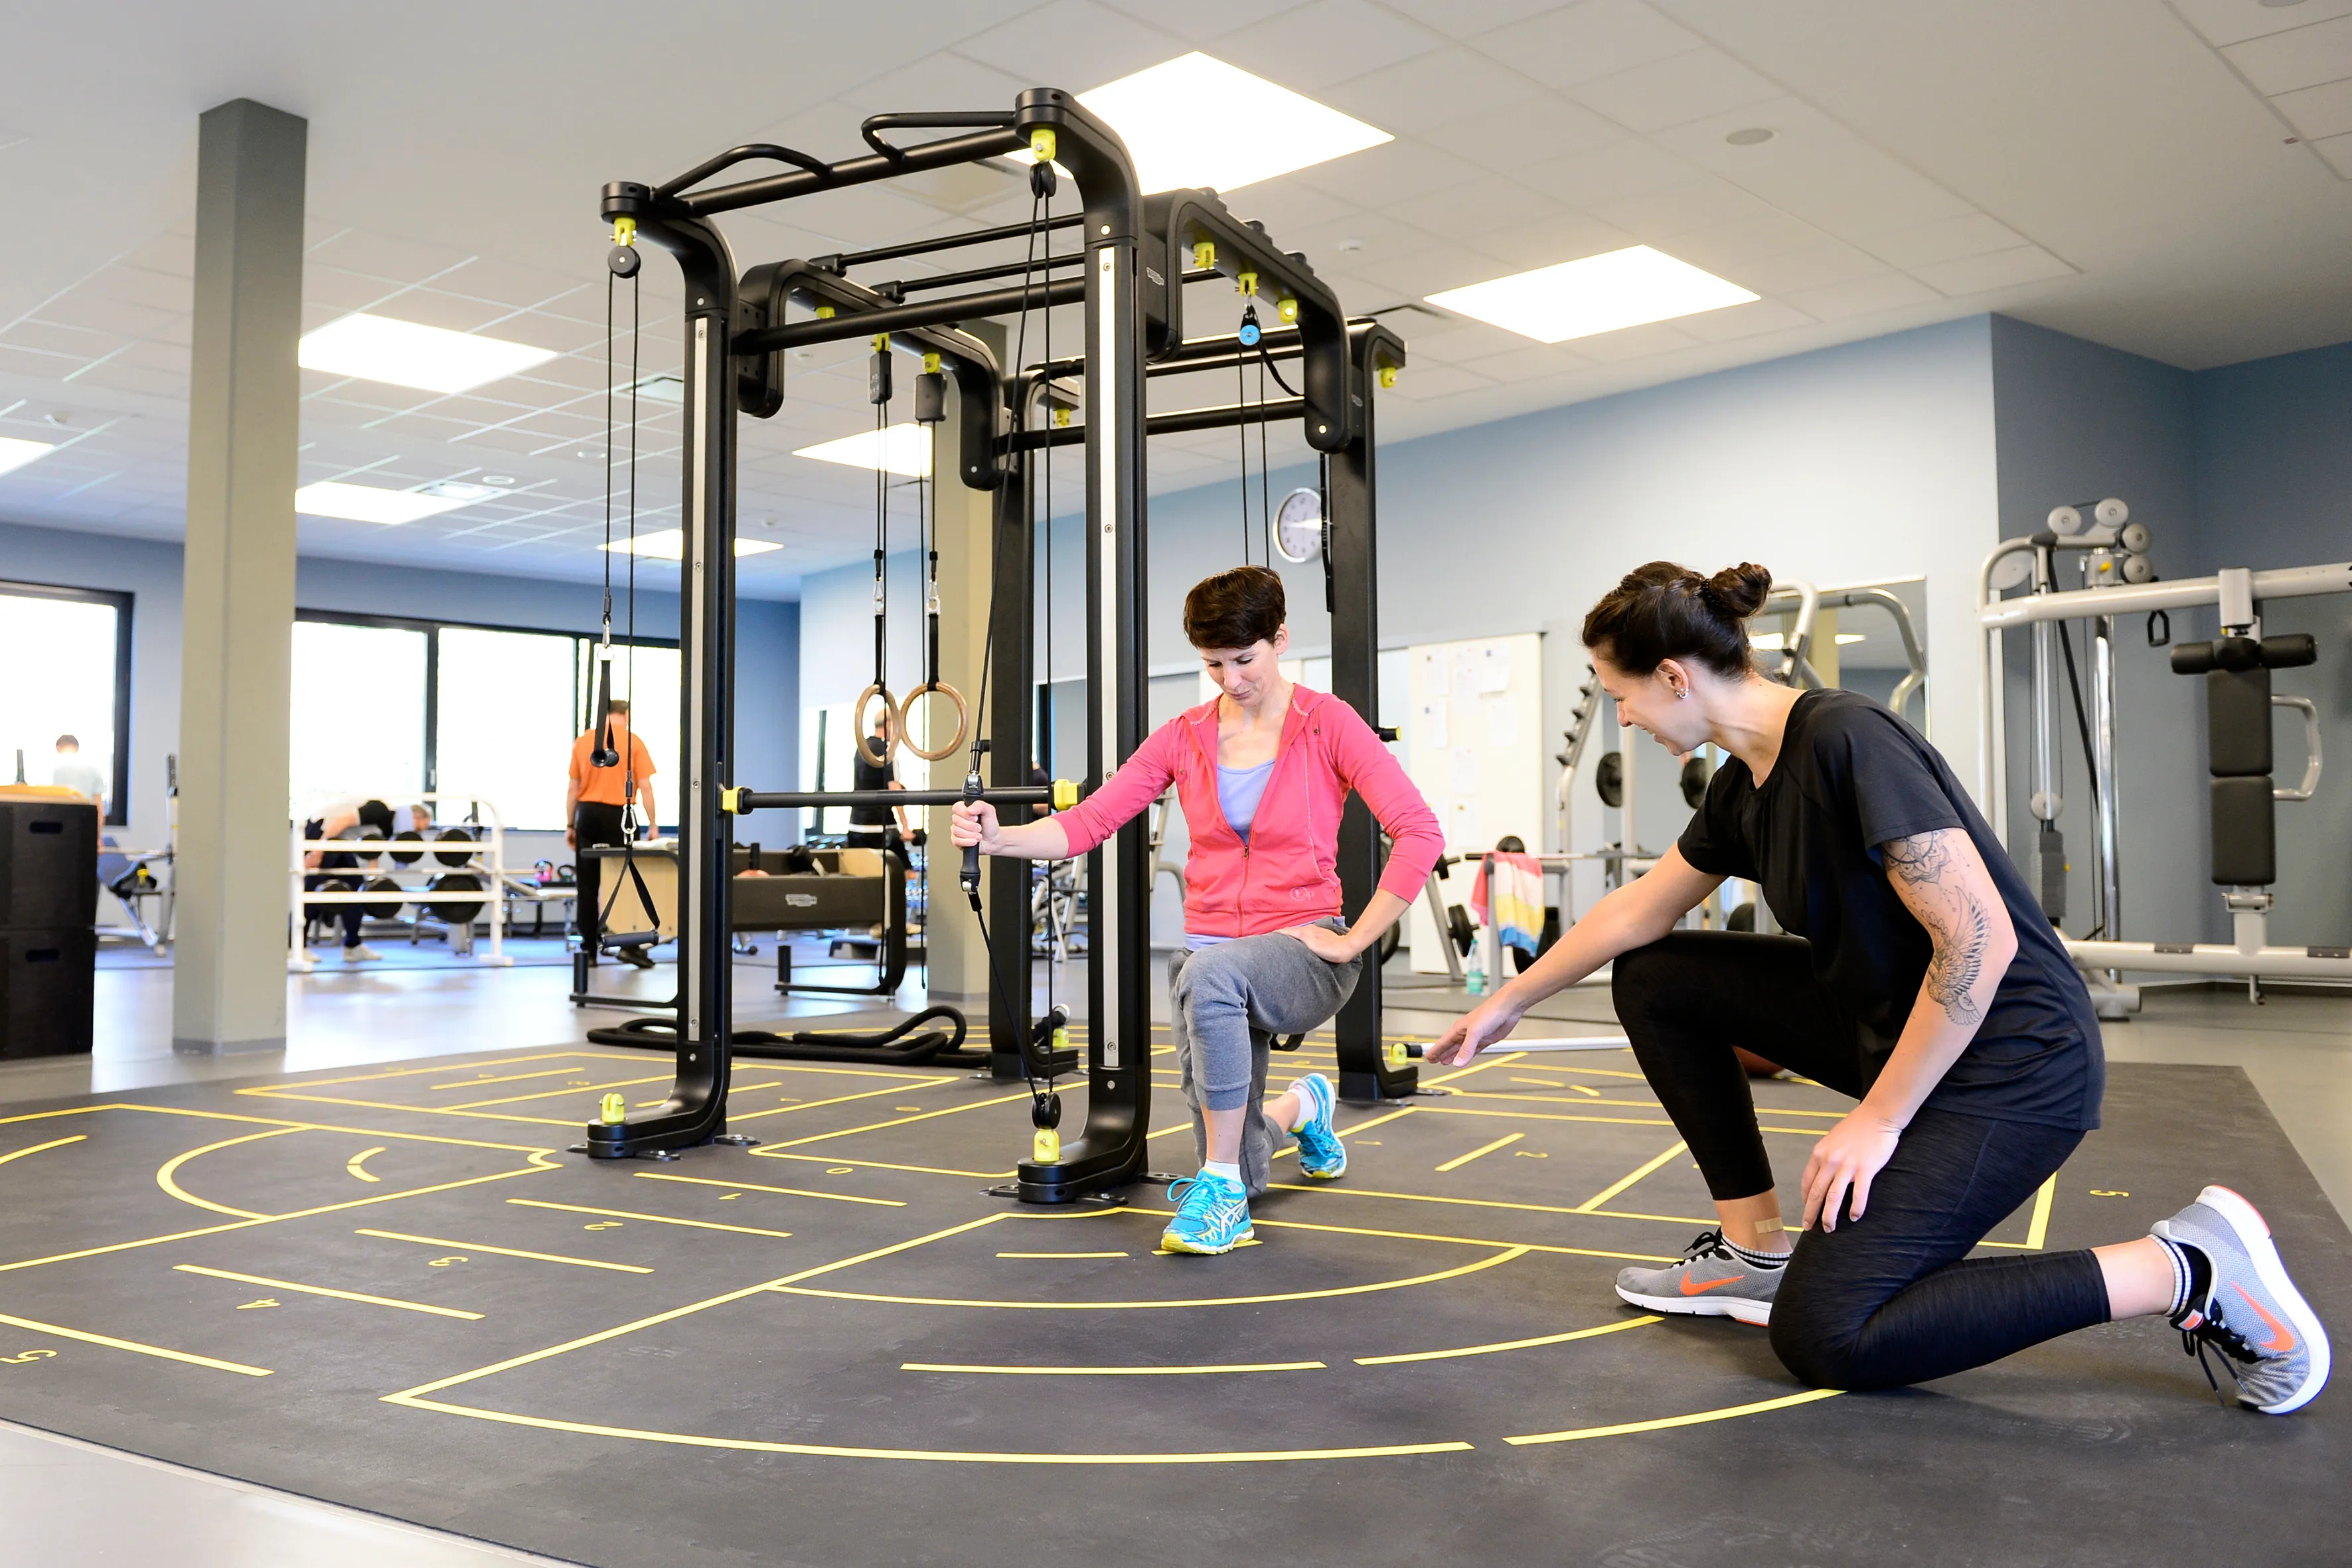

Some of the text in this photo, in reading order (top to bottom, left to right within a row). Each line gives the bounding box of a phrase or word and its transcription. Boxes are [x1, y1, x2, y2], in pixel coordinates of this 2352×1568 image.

[826, 1166, 854, 1175] 0
[2090, 1189, 2130, 1198] 5
[584, 1221, 623, 1231] 2
[430, 1255, 469, 1267] 3
[237, 1298, 280, 1310] 4
[0, 1349, 58, 1364] 5
